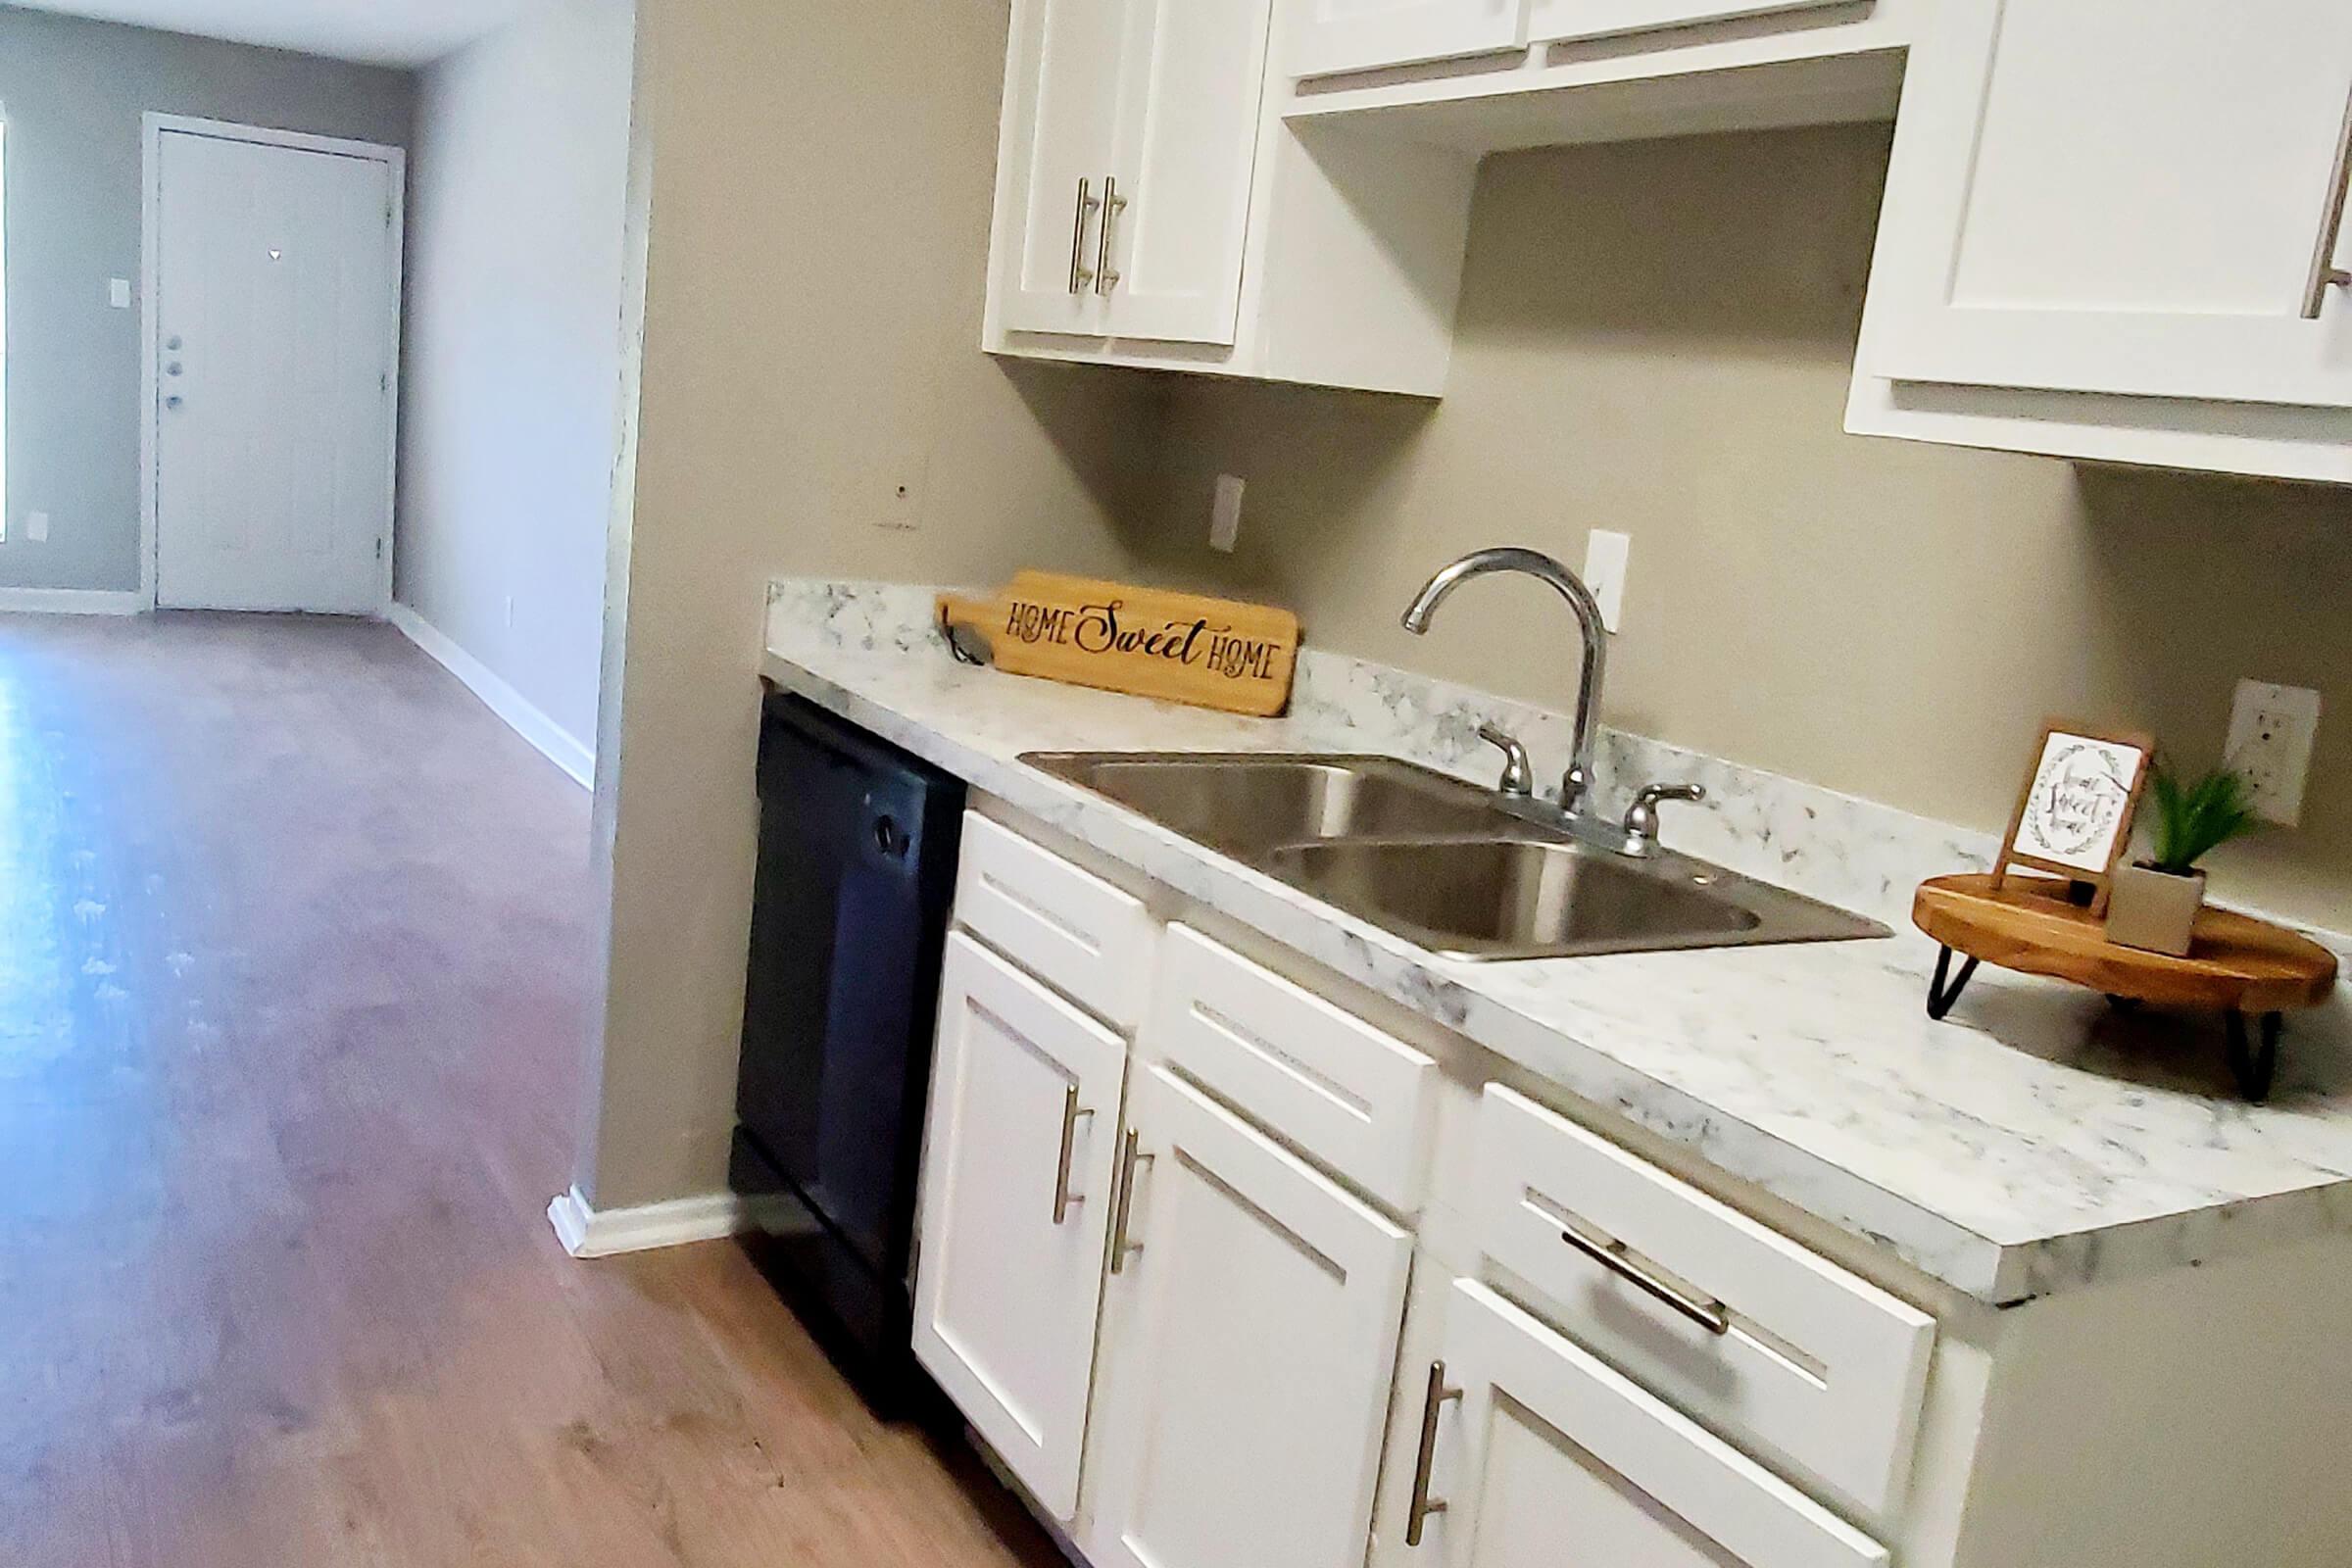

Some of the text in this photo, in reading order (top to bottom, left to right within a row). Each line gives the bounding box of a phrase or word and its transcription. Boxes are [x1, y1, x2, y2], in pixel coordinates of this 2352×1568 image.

[1006, 600, 1280, 679] HOME Sweet HOME
